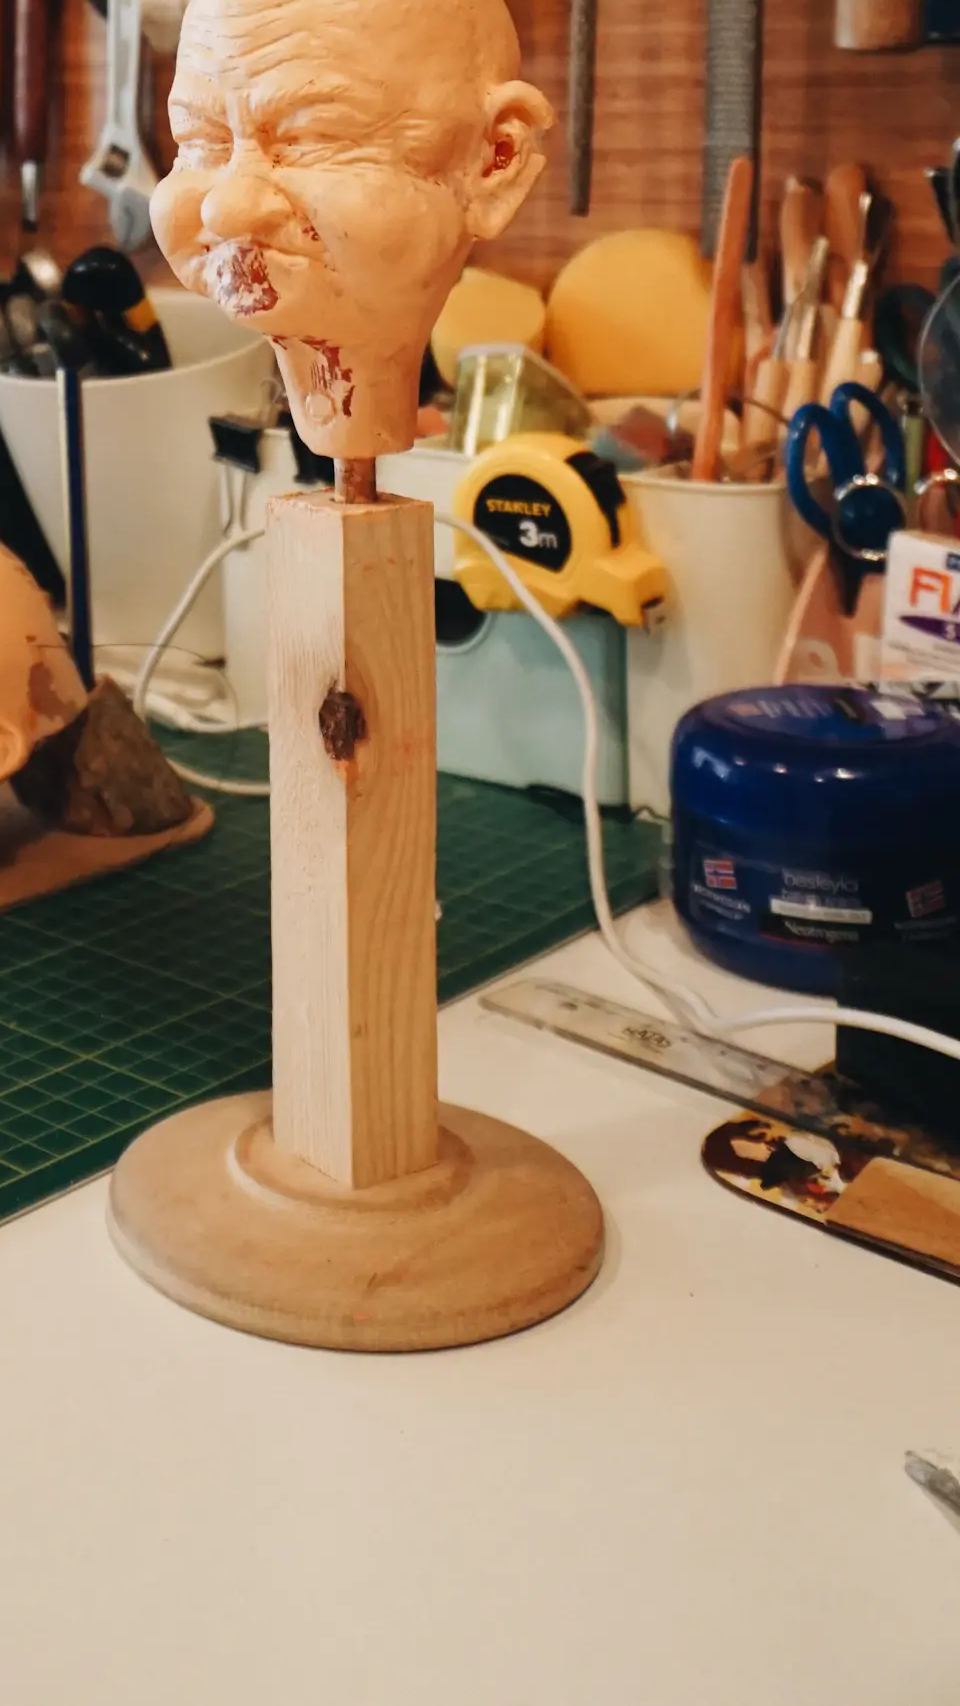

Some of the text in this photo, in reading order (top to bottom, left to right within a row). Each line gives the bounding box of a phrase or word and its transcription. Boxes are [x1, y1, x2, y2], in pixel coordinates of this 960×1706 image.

[486, 499, 551, 517] STANLEY
[518, 519, 558, 549] 3m
[909, 567, 960, 615] FI
